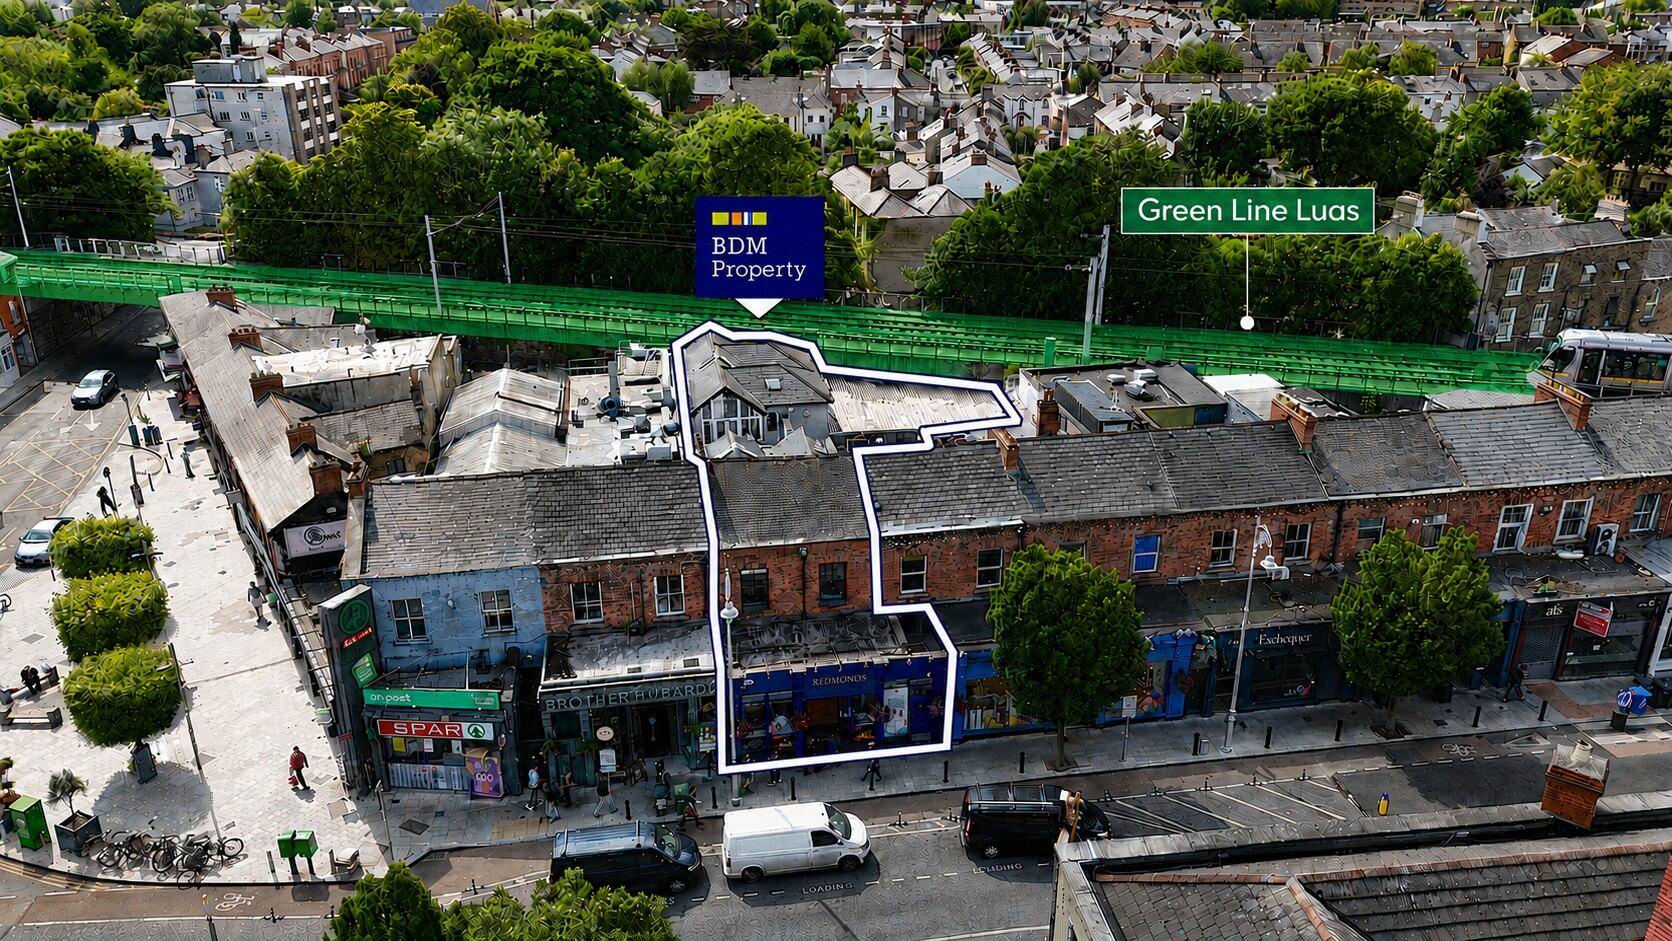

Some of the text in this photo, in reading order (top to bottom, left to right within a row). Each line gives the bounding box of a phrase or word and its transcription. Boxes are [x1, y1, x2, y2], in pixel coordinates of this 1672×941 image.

[812, 674, 867, 687] REDMONDS
[385, 693, 411, 705] post
[545, 691, 630, 711] BROTHER
[393, 723, 461, 737] SPAR
[802, 882, 853, 895] LOADING
